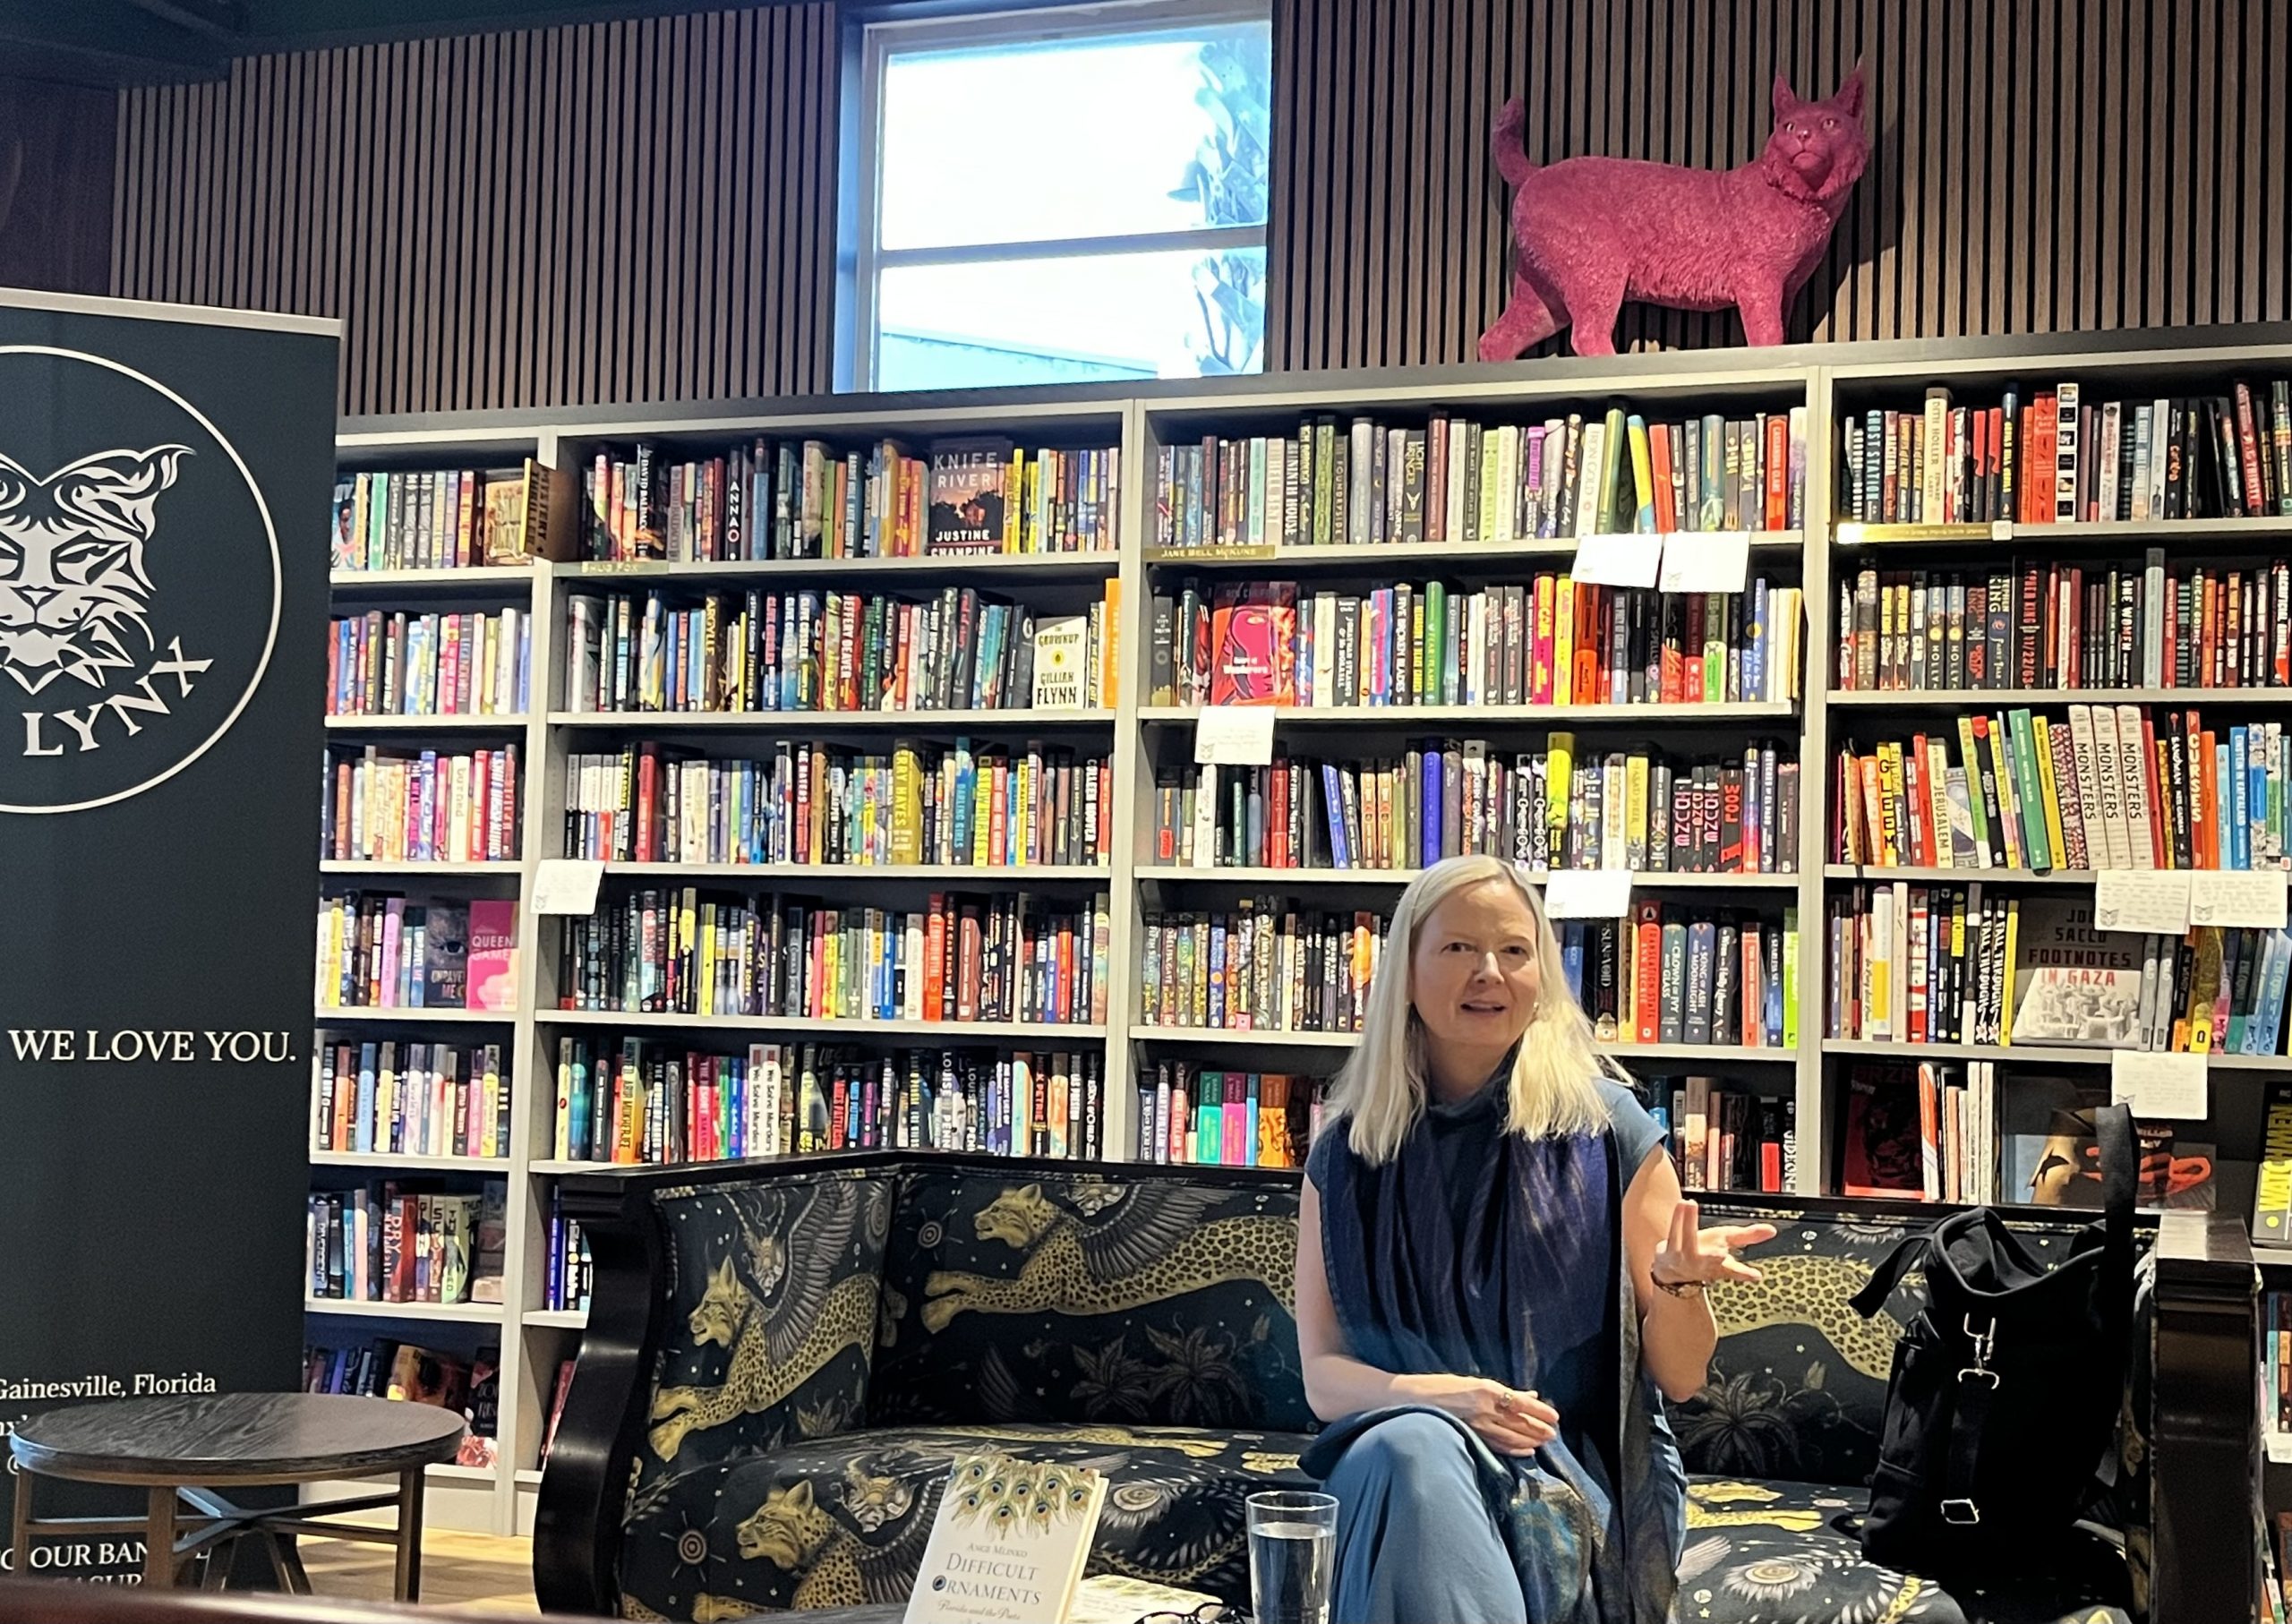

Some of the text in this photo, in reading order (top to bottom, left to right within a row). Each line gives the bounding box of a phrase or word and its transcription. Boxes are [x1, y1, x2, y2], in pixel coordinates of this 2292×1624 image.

[934, 452, 997, 471] KNIFE
[1867, 411, 1881, 500] GHOST STATION
[1930, 428, 1940, 466] HOLLER
[639, 459, 648, 489] DAVID
[937, 473, 992, 489] RIVER
[1269, 462, 1282, 490] HELL
[730, 482, 740, 527] ANNA
[1285, 459, 1298, 535] NINTH HOUSE
[1335, 461, 1344, 534] FOUNDRYSIDE
[935, 529, 990, 543] JUSTINE
[1988, 577, 2002, 613] KING
[706, 598, 716, 656] ARGYLLE
[841, 595, 855, 679] JEFFERY DEAVER
[1395, 596, 1407, 693] FIVE BROKEN BLADES
[2121, 606, 2132, 651] WOMEN
[1930, 645, 1939, 683] HOLLY
[1951, 645, 1959, 683] HOLLY
[22, 637, 213, 756] LYNX
[455, 768, 466, 817] burned
[1473, 774, 1481, 799] JOHN
[2076, 742, 2096, 820] MONSTERS
[2099, 742, 2117, 820] MONSTERS
[2123, 742, 2142, 820] MONSTERS
[2188, 733, 2202, 824] CURSES
[894, 786, 907, 826] HAYES
[976, 773, 990, 851] SLOW HORSES
[1084, 803, 1097, 842] HOOVER
[1933, 785, 1949, 849] JERUSALEM
[472, 935, 513, 948] QUEEN
[2028, 947, 2132, 968] FOOTNOTES
[1662, 969, 1671, 998] GLASS
[1670, 945, 1681, 1013] CROWN IVY
[1689, 954, 1699, 1013] MOONLIGHT
[1698, 952, 1708, 1007] SONG ASH
[1976, 921, 1992, 1013] FALL THROUGH
[1988, 921, 2006, 1013] FALL THROUGH
[2066, 969, 2116, 986] GAZA
[8, 1030, 295, 1062] WE LOVE YOU.
[941, 1052, 953, 1097] LOUISE
[752, 1068, 761, 1150] We Solve Murders
[765, 1069, 774, 1151] We Solve Murders
[1783, 1130, 1795, 1185] GIDEON
[392, 1216, 402, 1254] DRY
[0, 1372, 216, 1399] Gainesville, Florida
[30, 1547, 92, 1568] OUR
